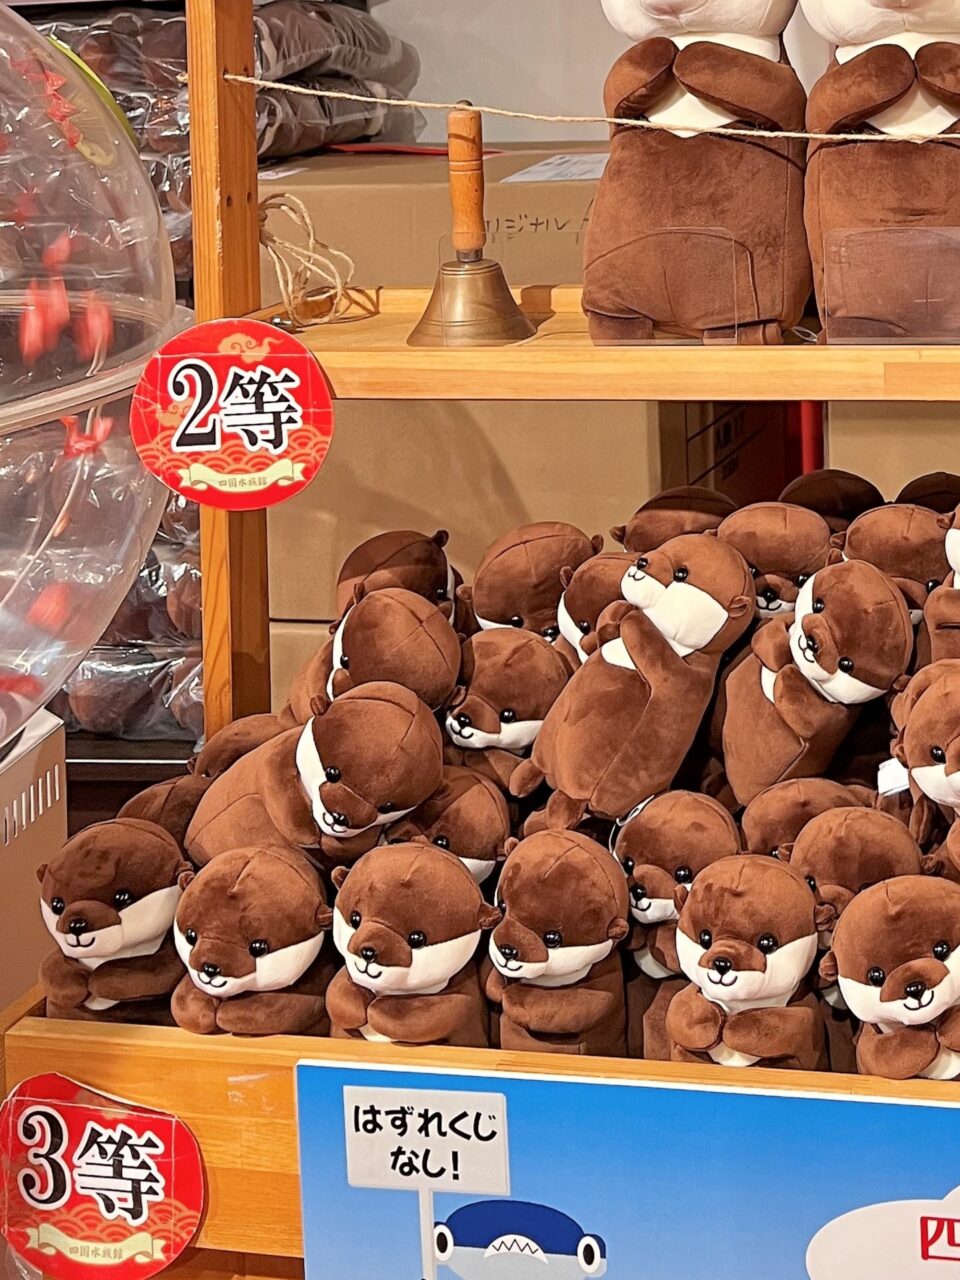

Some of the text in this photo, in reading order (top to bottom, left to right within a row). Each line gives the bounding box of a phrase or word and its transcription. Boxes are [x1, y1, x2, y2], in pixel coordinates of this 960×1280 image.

[172, 362, 300, 451] 2等
[21, 1109, 161, 1221] 3等
[353, 1104, 498, 1142] はずれくじ
